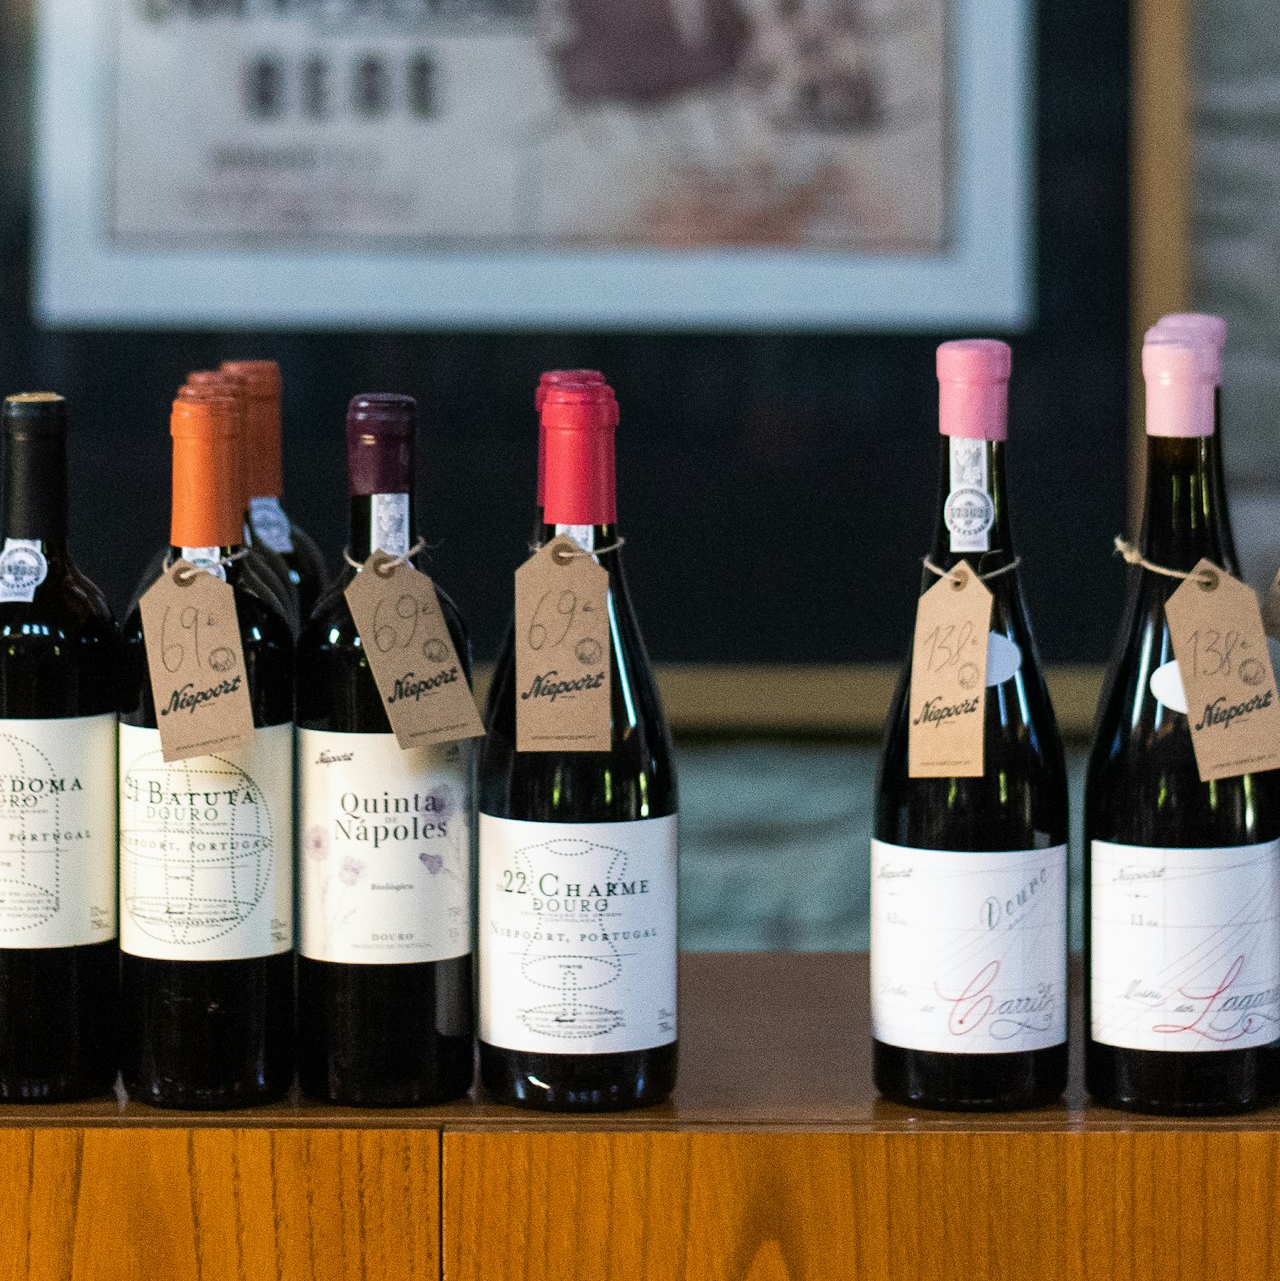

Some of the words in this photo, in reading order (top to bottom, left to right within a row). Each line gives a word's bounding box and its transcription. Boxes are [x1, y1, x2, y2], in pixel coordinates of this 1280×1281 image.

[160, 675, 242, 716] Niepoort
[388, 666, 459, 703] Niepoort
[521, 670, 606, 702] Niepoort
[912, 695, 980, 728] Niepoort
[1195, 689, 1272, 731] Niepoort
[148, 781, 258, 805] BATUTA
[340, 791, 439, 819] Quinta
[146, 806, 219, 822] DOURO
[334, 816, 449, 849] Nápoles
[503, 870, 527, 895] 22
[538, 873, 649, 898] CHARME
[533, 897, 610, 913] DOURO
[371, 932, 415, 942] DOURO
[490, 920, 570, 943] NIEPOORT,
[579, 927, 657, 943] PORTUGAL
